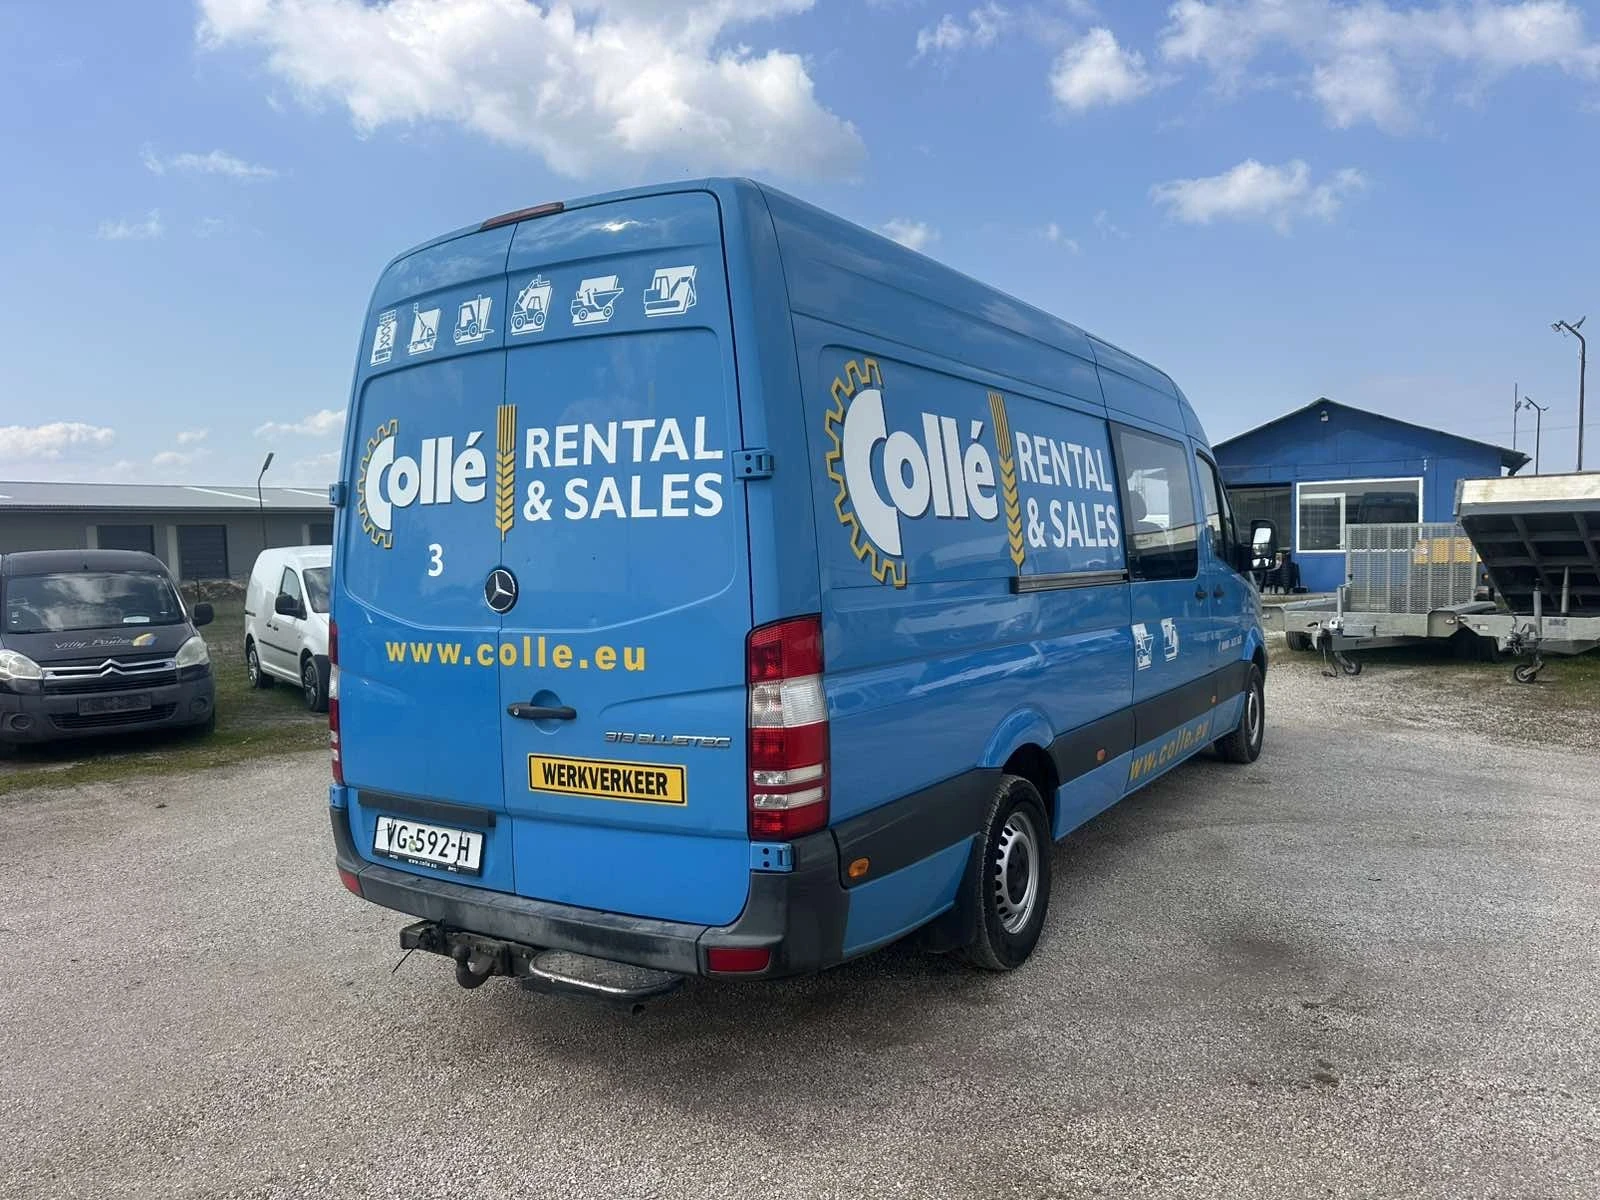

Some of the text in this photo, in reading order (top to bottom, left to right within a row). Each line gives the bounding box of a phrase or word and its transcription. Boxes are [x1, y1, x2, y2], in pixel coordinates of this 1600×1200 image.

[525, 416, 724, 469] RENTAL
[1015, 431, 1113, 493] RENTAL
[365, 431, 487, 531] Collé
[523, 472, 724, 521] & SALES
[843, 389, 998, 556] Collé
[1026, 497, 1120, 549] & SALES
[428, 543, 444, 577] 3
[385, 636, 647, 672] www.colle.eu
[541, 762, 669, 797] WERKVERKEER
[386, 821, 471, 863] VG-592-H
